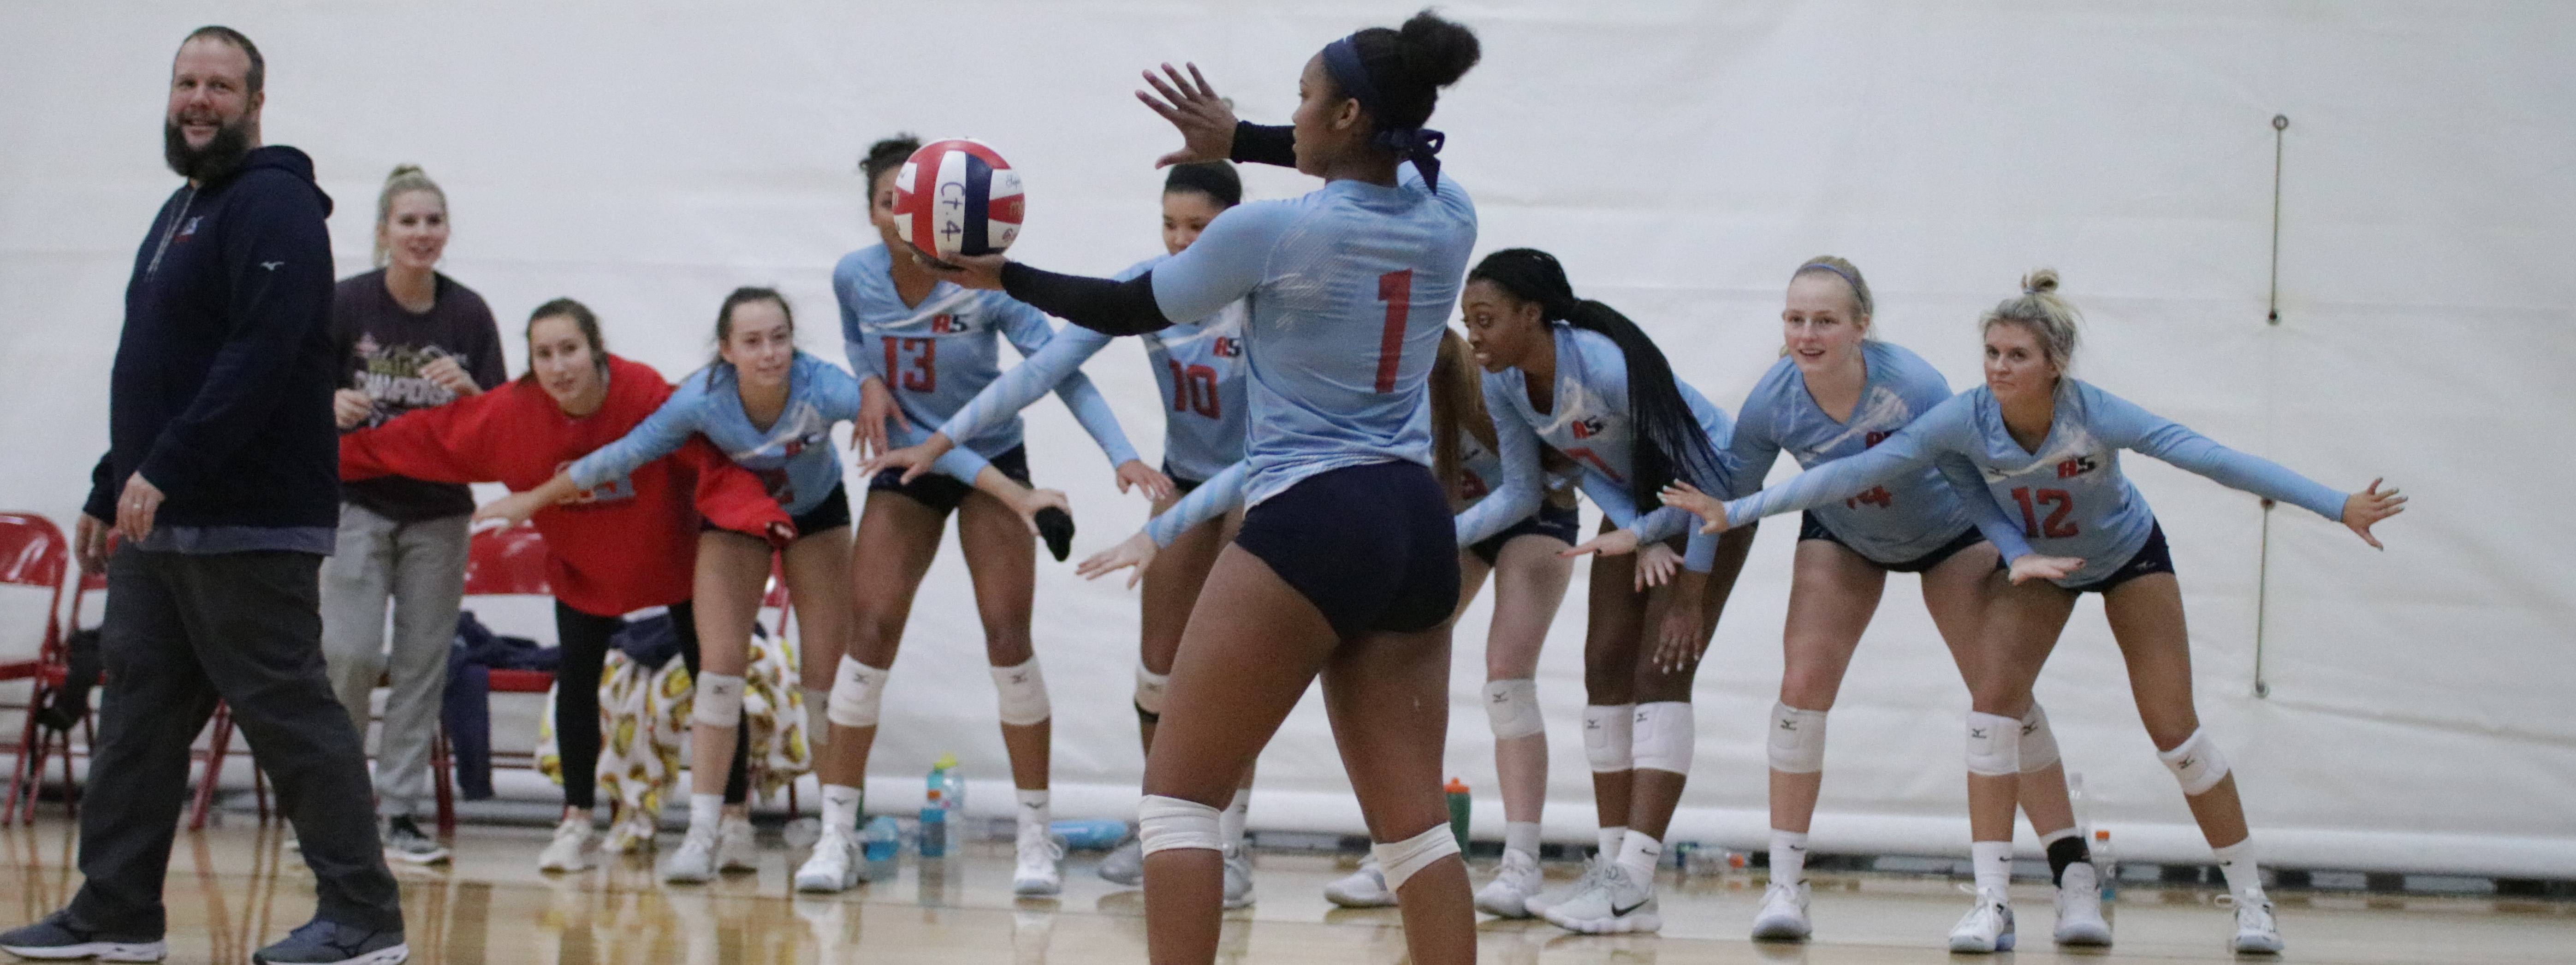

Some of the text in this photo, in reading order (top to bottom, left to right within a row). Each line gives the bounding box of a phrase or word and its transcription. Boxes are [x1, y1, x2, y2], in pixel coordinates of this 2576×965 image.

[1375, 268, 1413, 393] 1
[880, 336, 936, 393] 13
[1169, 358, 1221, 419] 10
[2011, 486, 2079, 538] 12
